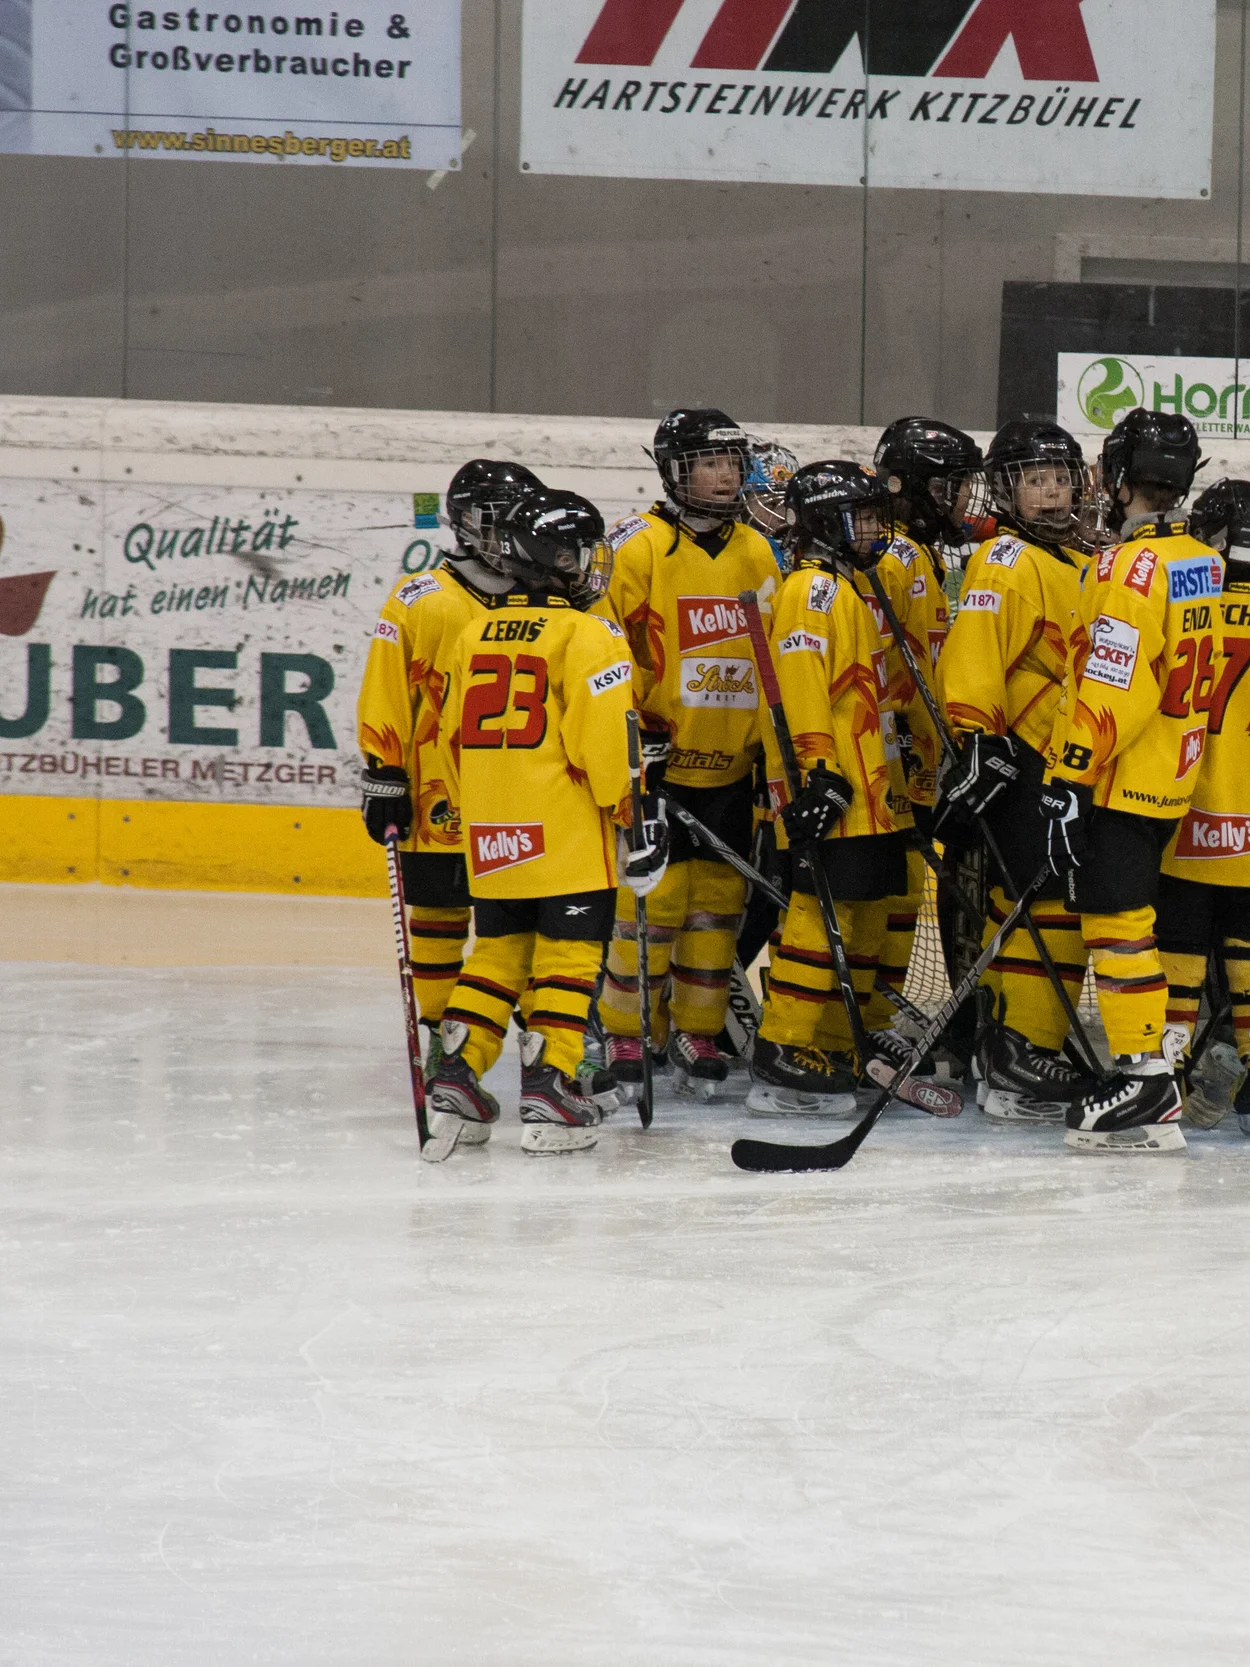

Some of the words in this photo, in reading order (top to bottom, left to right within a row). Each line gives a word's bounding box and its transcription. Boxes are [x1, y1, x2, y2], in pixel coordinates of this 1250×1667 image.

[109, 3, 364, 38] Gastronomie
[387, 14, 411, 39] &
[109, 43, 412, 79] Großverbraucher
[554, 78, 900, 121] HARTSTEINWERK
[910, 87, 1142, 129] KITZBÜHEL
[112, 129, 412, 161] www.sinnesberger.at
[124, 508, 300, 570] Qualität
[81, 587, 136, 620] hat
[151, 581, 228, 613] einen
[237, 572, 352, 606] Namen
[480, 617, 548, 642] LEBIŠ
[689, 604, 748, 635] Kelly's
[461, 653, 550, 750] 23
[191, 758, 337, 784] METZGER
[477, 829, 534, 862] Kelly's
